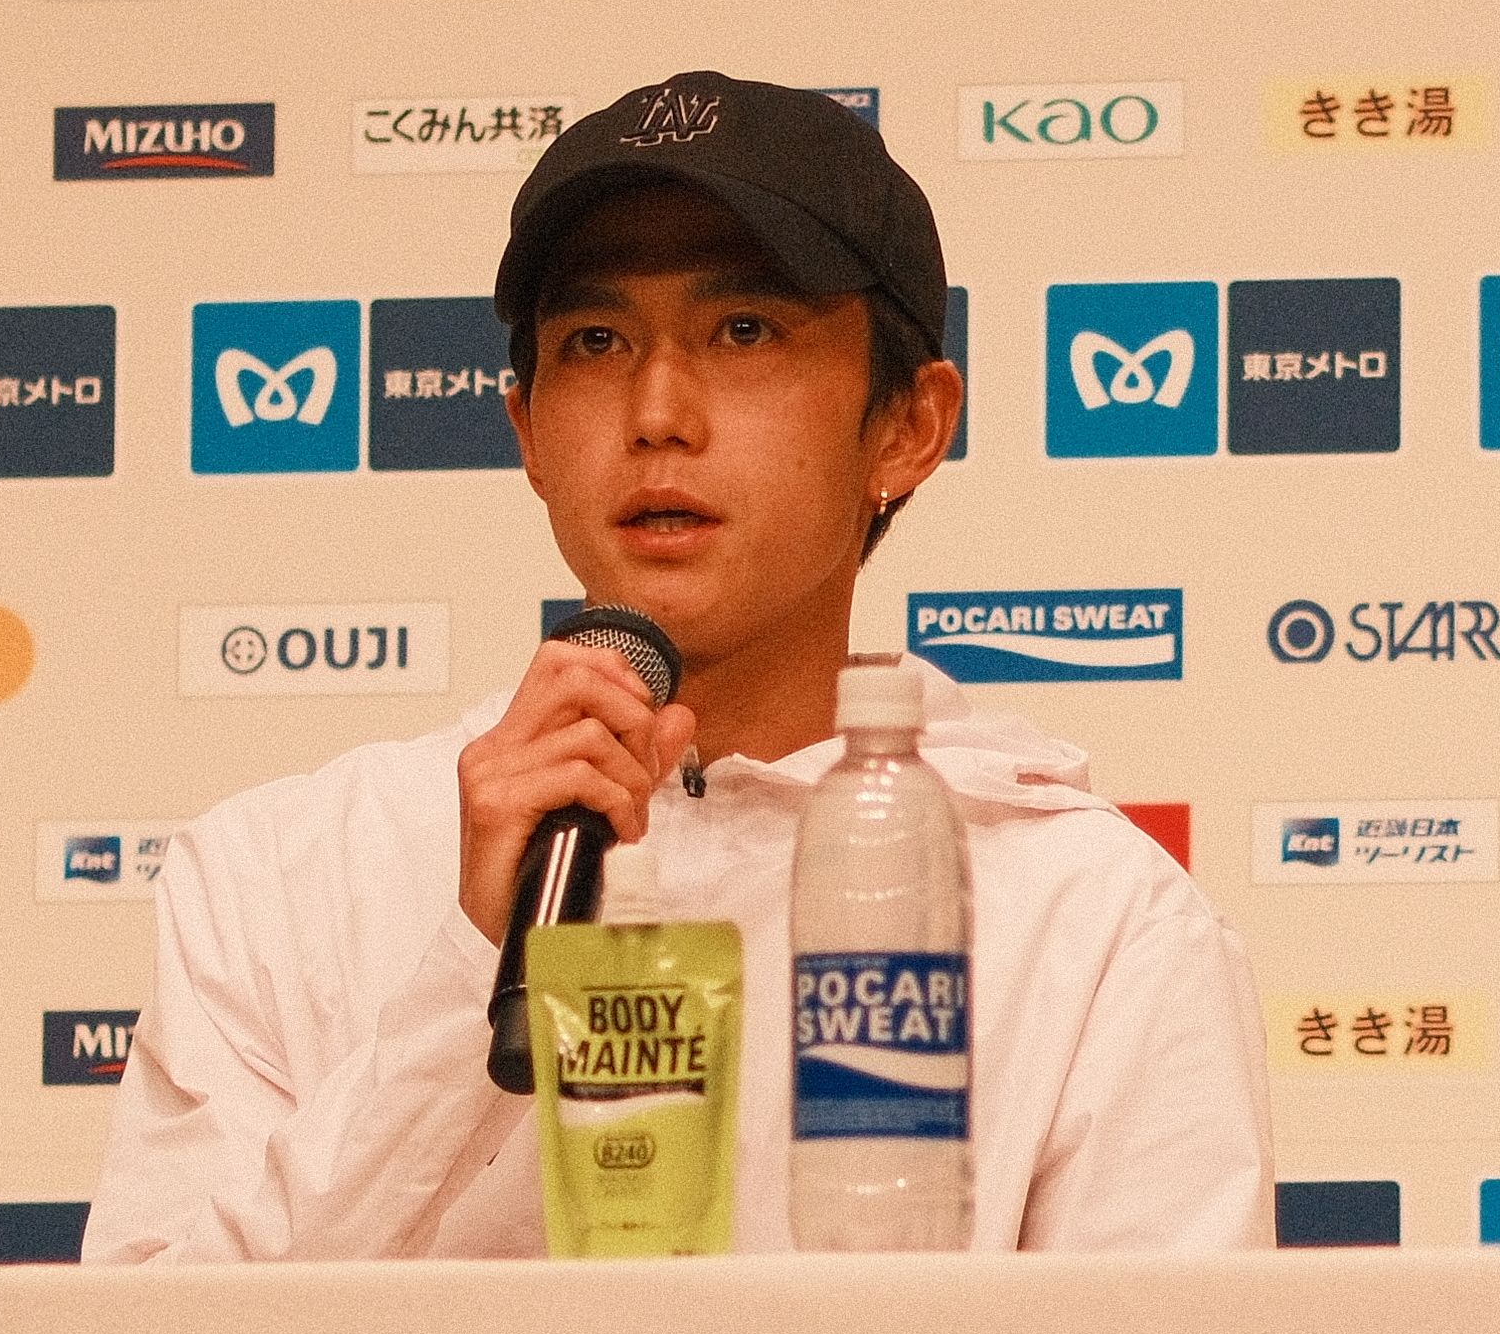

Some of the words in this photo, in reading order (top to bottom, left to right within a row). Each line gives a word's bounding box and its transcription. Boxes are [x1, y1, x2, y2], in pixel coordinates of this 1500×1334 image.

[365, 106, 563, 143] こくみん共済
[1300, 87, 1454, 139] きき湯
[85, 120, 244, 152] MIZUHO
[1244, 352, 1386, 380] 東京メトロ
[918, 607, 1046, 636] POCARI
[1054, 605, 1168, 630] SWEAT
[277, 627, 407, 670] OUJI
[798, 970, 964, 1008] POCARI
[589, 994, 684, 1034] BODY
[798, 1006, 956, 1043] SWEAT
[1298, 1006, 1452, 1056] きき湯
